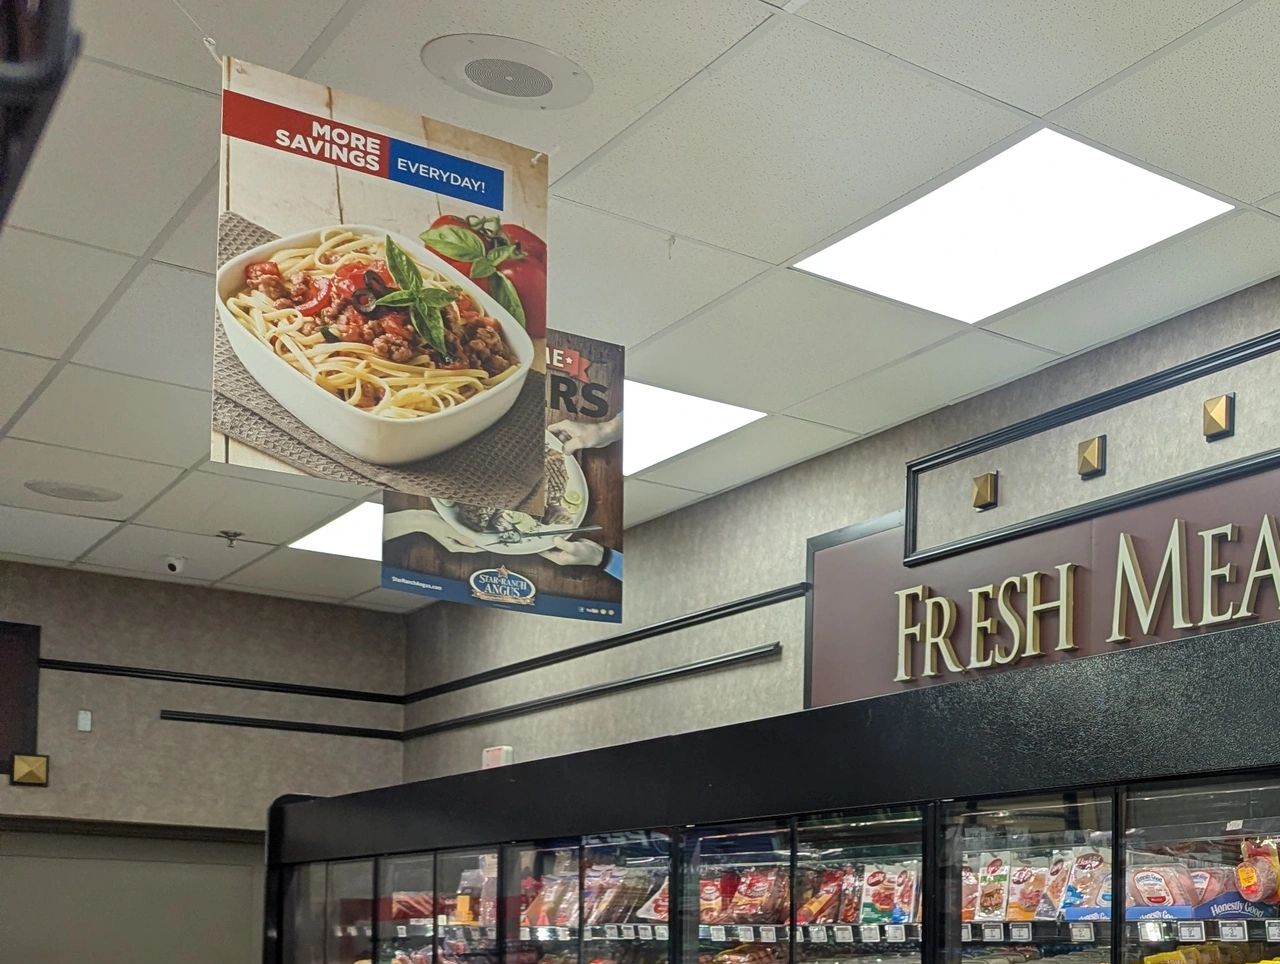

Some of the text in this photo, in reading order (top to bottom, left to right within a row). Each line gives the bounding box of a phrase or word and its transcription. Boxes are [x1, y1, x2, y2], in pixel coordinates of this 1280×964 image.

[276, 129, 380, 171] SAVINGS
[312, 121, 381, 156] MORE
[397, 158, 486, 193] EVERYDAY!
[484, 584, 521, 597] ANGUS
[501, 577, 527, 590] RANCH
[893, 562, 1081, 683] FRESH
[1211, 901, 1264, 917] Honestly Good
